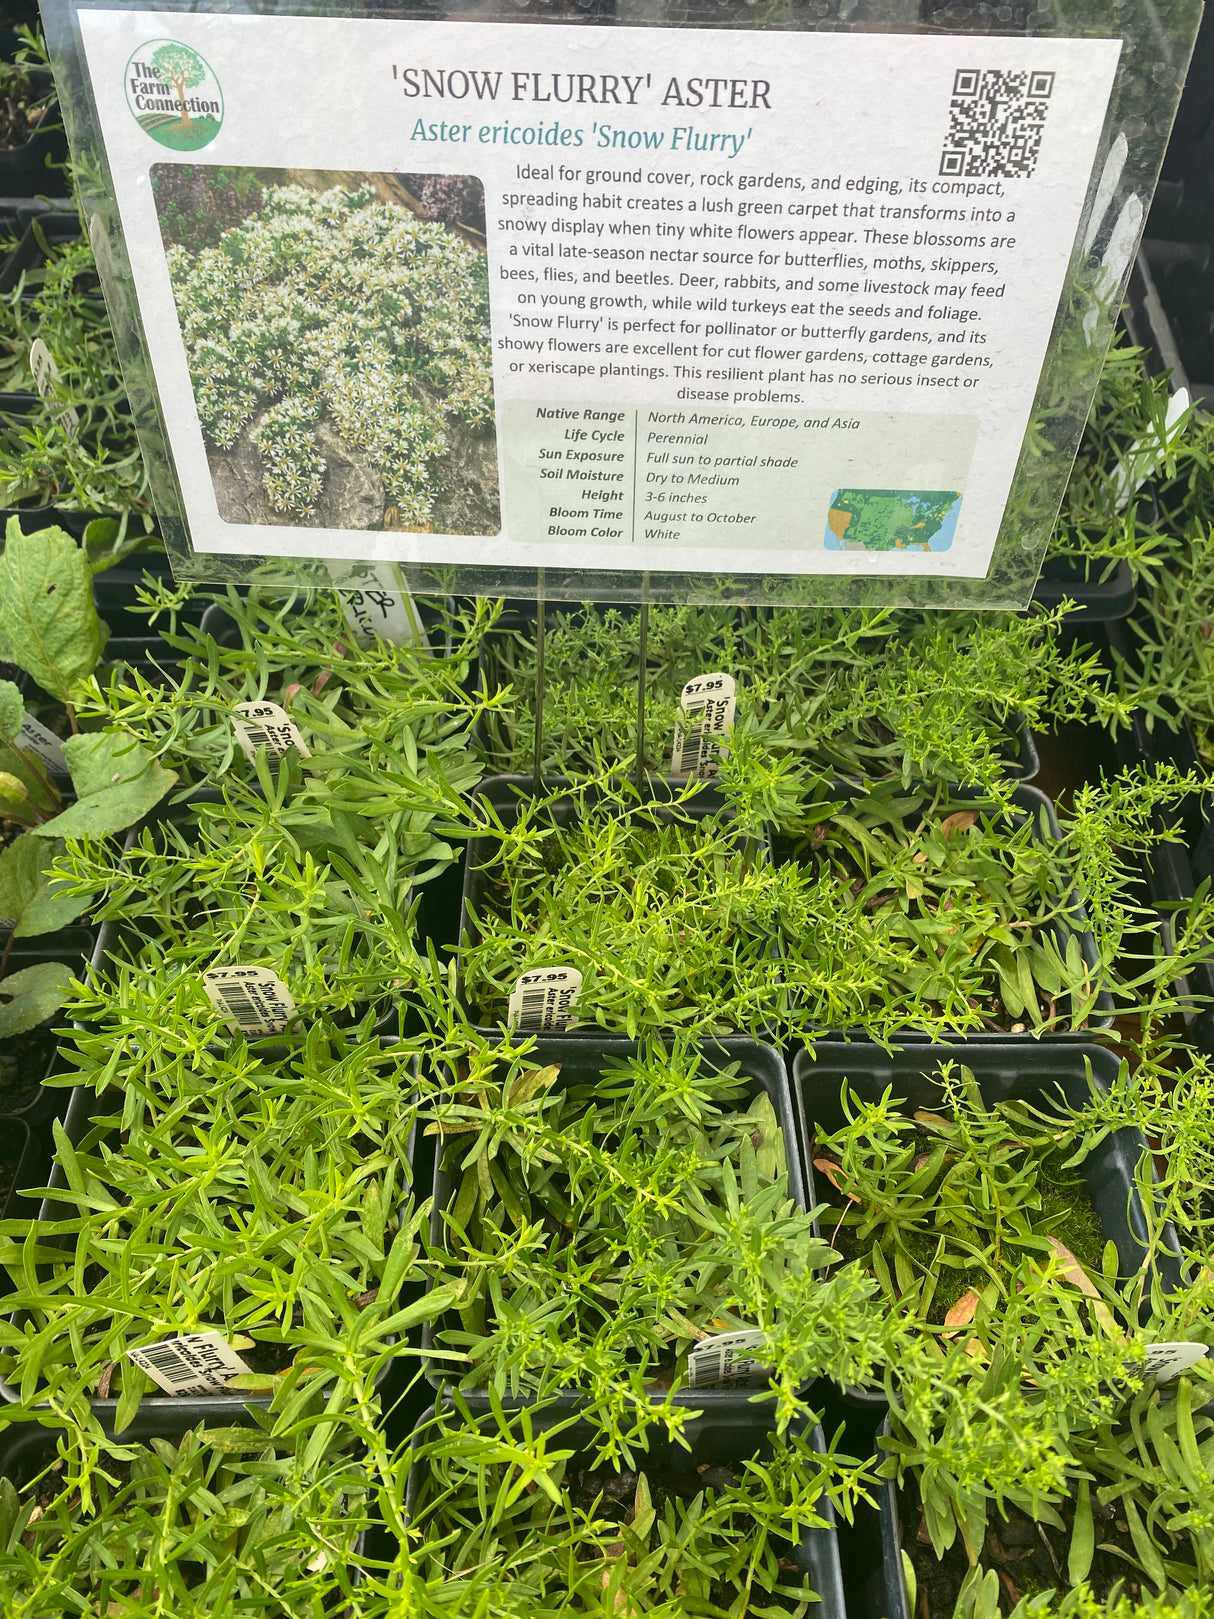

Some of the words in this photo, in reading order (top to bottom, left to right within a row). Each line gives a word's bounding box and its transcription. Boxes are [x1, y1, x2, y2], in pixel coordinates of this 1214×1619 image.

[132, 61, 161, 79] The
[130, 77, 170, 97] Farm
[392, 64, 503, 100] 'SNOW
[510, 71, 651, 104] FLURRY'
[660, 76, 771, 109] ASTER
[134, 94, 220, 114] Connection
[409, 117, 472, 142] Aster
[478, 119, 583, 146] ericoides
[592, 121, 664, 149] 'Snow
[669, 125, 753, 159] Flurry'
[516, 163, 553, 180] Ideal
[557, 164, 582, 181] for
[585, 167, 642, 185] ground
[646, 172, 694, 187] cover,
[699, 170, 733, 186] rock
[737, 171, 805, 191] gardens,
[810, 174, 841, 190] and
[845, 175, 902, 195] edging,
[908, 178, 927, 193] its
[931, 181, 1004, 198] compact,
[501, 191, 578, 211] spreading
[582, 192, 622, 209] habit
[626, 196, 683, 211] creates
[687, 200, 696, 211] a
[701, 196, 733, 212] lush
[737, 201, 783, 217] green
[787, 202, 838, 219] carpet
[842, 201, 875, 218] that
[879, 203, 966, 221] transforms
[970, 206, 1002, 222] into
[1005, 211, 1015, 222] a
[497, 218, 547, 235] snowy
[551, 217, 604, 237] display
[608, 219, 650, 235] when
[655, 222, 685, 240] tiny
[689, 222, 733, 238] white
[737, 223, 794, 240] flowers
[798, 230, 857, 245] appear.
[863, 227, 909, 244] These
[912, 230, 986, 247] blossoms
[989, 236, 1016, 248] are
[508, 244, 517, 255] a
[521, 242, 554, 257] vital
[558, 242, 644, 260] late-season
[649, 248, 699, 262] nectar
[702, 251, 753, 264] source
[757, 249, 780, 265] for
[784, 250, 867, 269] butterflies,
[872, 255, 925, 272] moths,
[929, 256, 998, 275] skippers,
[499, 264, 538, 283] bees,
[542, 266, 577, 284] flies,
[582, 268, 610, 283] and
[615, 269, 673, 285] beetles.
[679, 272, 718, 290] Deer,
[723, 273, 780, 292] rabbits,
[784, 276, 814, 290] and
[817, 280, 859, 292] some
[863, 278, 930, 295] livestock
[933, 284, 967, 299] may
[970, 282, 1006, 297] feed
[517, 293, 536, 304] on
[540, 294, 586, 309] young
[589, 293, 647, 311] growth,
[651, 295, 692, 310] while
[695, 297, 727, 311] wild
[731, 298, 786, 316] turkeys
[790, 301, 815, 314] eat
[819, 301, 844, 315] the
[847, 302, 891, 317] seeds
[894, 304, 924, 318] and
[927, 304, 981, 323] foliage.
[509, 312, 553, 328] 'Snow
[557, 314, 603, 332] Flurry'
[607, 317, 618, 330] is
[622, 318, 675, 334] perfect
[679, 319, 701, 333] for
[704, 321, 777, 337] pollinator
[780, 326, 797, 337] or
[800, 323, 866, 342] butterfly
[868, 327, 932, 344] gardens,
[936, 329, 966, 343] and
[969, 330, 986, 344] its
[497, 335, 544, 353] showy
[547, 337, 601, 353] flowers
[604, 343, 628, 354] are
[632, 341, 698, 356] excellent
[701, 343, 724, 357] for
[727, 346, 750, 358] cut
[754, 345, 802, 360] flower
[804, 347, 867, 364] gardens,
[871, 351, 927, 367] cottage
[930, 352, 993, 368] gardens,
[509, 362, 524, 372] or
[528, 360, 595, 377] xeriscape
[599, 362, 668, 380] plantings.
[672, 364, 702, 378] This
[705, 366, 764, 381] resilient
[767, 368, 805, 384] plant
[809, 369, 833, 383] has
[837, 373, 856, 383] no
[860, 372, 912, 385] serious
[916, 373, 960, 387] insect
[962, 378, 979, 387] or
[676, 386, 729, 401] disease
[733, 388, 804, 404] problems.
[535, 407, 579, 419] Native
[582, 408, 625, 423] Range
[647, 411, 685, 423] North
[687, 412, 745, 427] America,
[750, 414, 799, 429] Europe,
[803, 416, 830, 428] and
[830, 417, 860, 429] Asia
[564, 428, 587, 442] Life
[590, 429, 625, 443] Cycle
[647, 431, 708, 445] Perennial
[537, 447, 562, 459] Sun
[565, 448, 624, 463] Exposure
[646, 451, 670, 463] Full
[671, 455, 694, 464] sun
[698, 454, 711, 464] to
[713, 455, 758, 467] partial
[759, 455, 798, 468] shade
[539, 467, 563, 479] Soil
[565, 468, 624, 481] Moisture
[645, 471, 668, 485] Dry
[670, 473, 684, 483] to
[686, 473, 739, 485] Medium
[581, 489, 624, 502] Height
[644, 491, 666, 502] 3-6
[668, 492, 707, 503] inches
[548, 506, 589, 518] Bloom
[592, 508, 623, 519] Time
[643, 510, 687, 523] August
[690, 512, 703, 522] to
[706, 512, 756, 523] October
[547, 525, 587, 536] Bloom
[590, 526, 623, 537] Color
[644, 528, 680, 539] White
[685, 680, 723, 694] $7.95
[235, 707, 274, 718] 7.95
[713, 696, 731, 731] 'Snow
[264, 724, 283, 747] Aster
[277, 723, 297, 750] 'Sno
[206, 970, 259, 980] $7.95
[521, 972, 568, 985] $7.95
[258, 980, 280, 1002] 'Snow
[547, 987, 559, 1005] Aster
